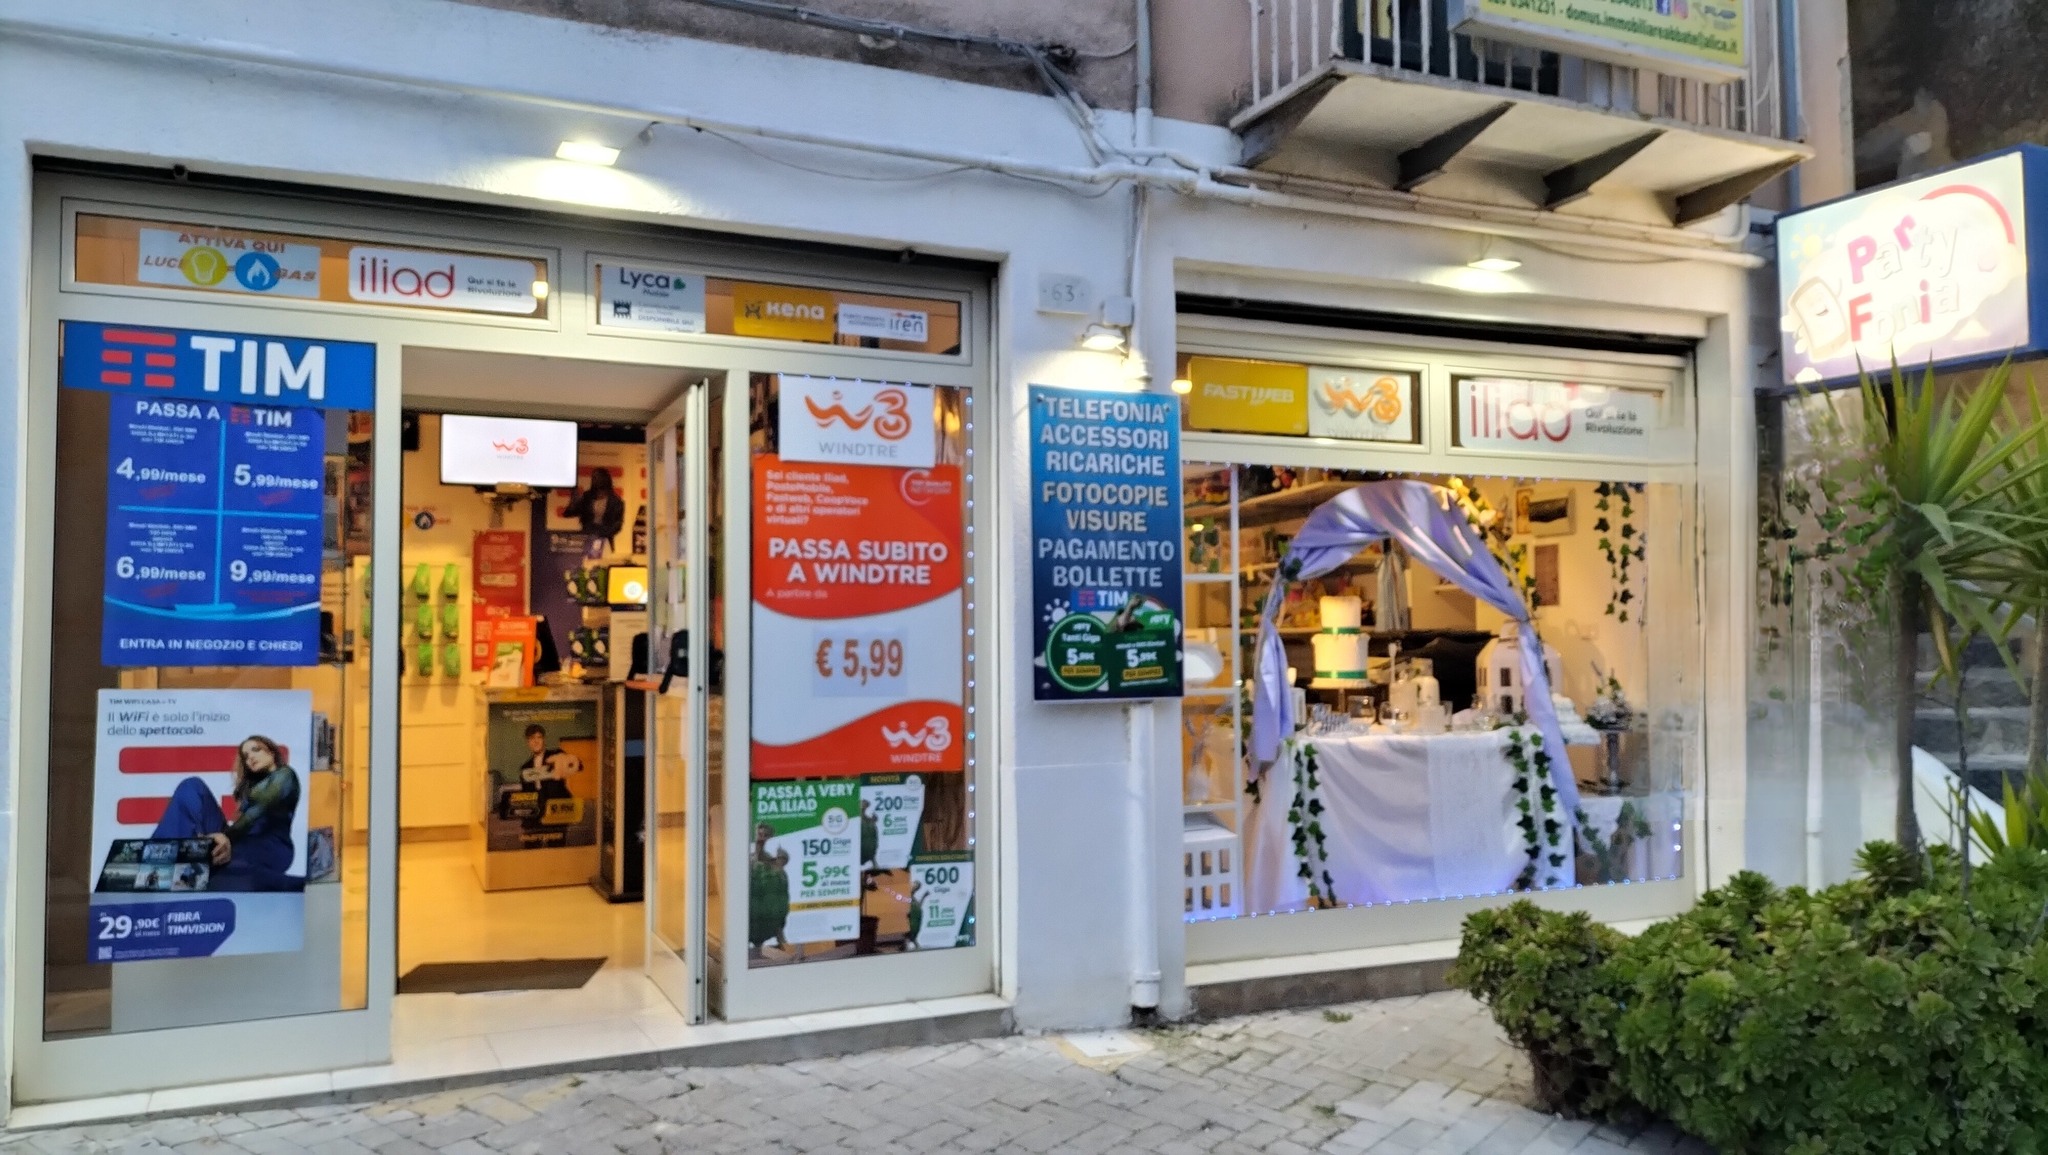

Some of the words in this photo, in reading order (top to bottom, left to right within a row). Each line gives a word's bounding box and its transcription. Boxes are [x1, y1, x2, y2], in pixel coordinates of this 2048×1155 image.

[178, 232, 246, 250] ATTIVA
[252, 241, 285, 254] QUI
[360, 257, 455, 298] iliad
[620, 267, 670, 289] Lyca
[467, 287, 522, 297] Rivoluzione
[1051, 284, 1075, 302] 63
[190, 336, 326, 400] TIM
[136, 401, 202, 420] PASSA
[207, 406, 220, 420] A
[254, 409, 292, 428] TIM
[1046, 397, 1165, 424] TELEFONIA
[1041, 424, 1169, 450] ACCESSORI
[819, 442, 898, 458] WINDTRE
[1046, 451, 1165, 476] RICARICHE
[1042, 482, 1168, 507] FOTOCOPIE
[1066, 508, 1147, 532] VISURE
[768, 537, 851, 560] PASSA
[858, 539, 948, 562] SUBITO
[1038, 538, 1175, 561] PAGAMENTO
[787, 562, 806, 583] A
[813, 562, 931, 585] WINDTRE
[1053, 565, 1163, 588] BOLLETTE
[1097, 590, 1128, 606] TIM
[120, 638, 165, 650] ENTRA
[168, 639, 182, 650] IN
[186, 639, 245, 651] NEGOZIO
[247, 640, 256, 651] E
[258, 640, 303, 651] CHIEDI
[816, 638, 833, 678] €
[843, 638, 903, 687] 5,99
[108, 712, 115, 722] Il
[120, 712, 150, 722] WiFi
[163, 713, 189, 722] solo
[107, 725, 137, 735] dello
[890, 752, 943, 763] WINDTRE
[757, 786, 804, 800] PASSA
[805, 785, 816, 797] A
[818, 783, 856, 797] VERY
[757, 800, 780, 814] DA
[781, 799, 818, 813] ILIAD
[874, 796, 903, 811] 200
[801, 838, 832, 856] 150
[801, 861, 850, 888] 5,99€
[925, 866, 959, 885] 600
[167, 911, 201, 923] FIBRA
[168, 922, 226, 935] TIMVISION
